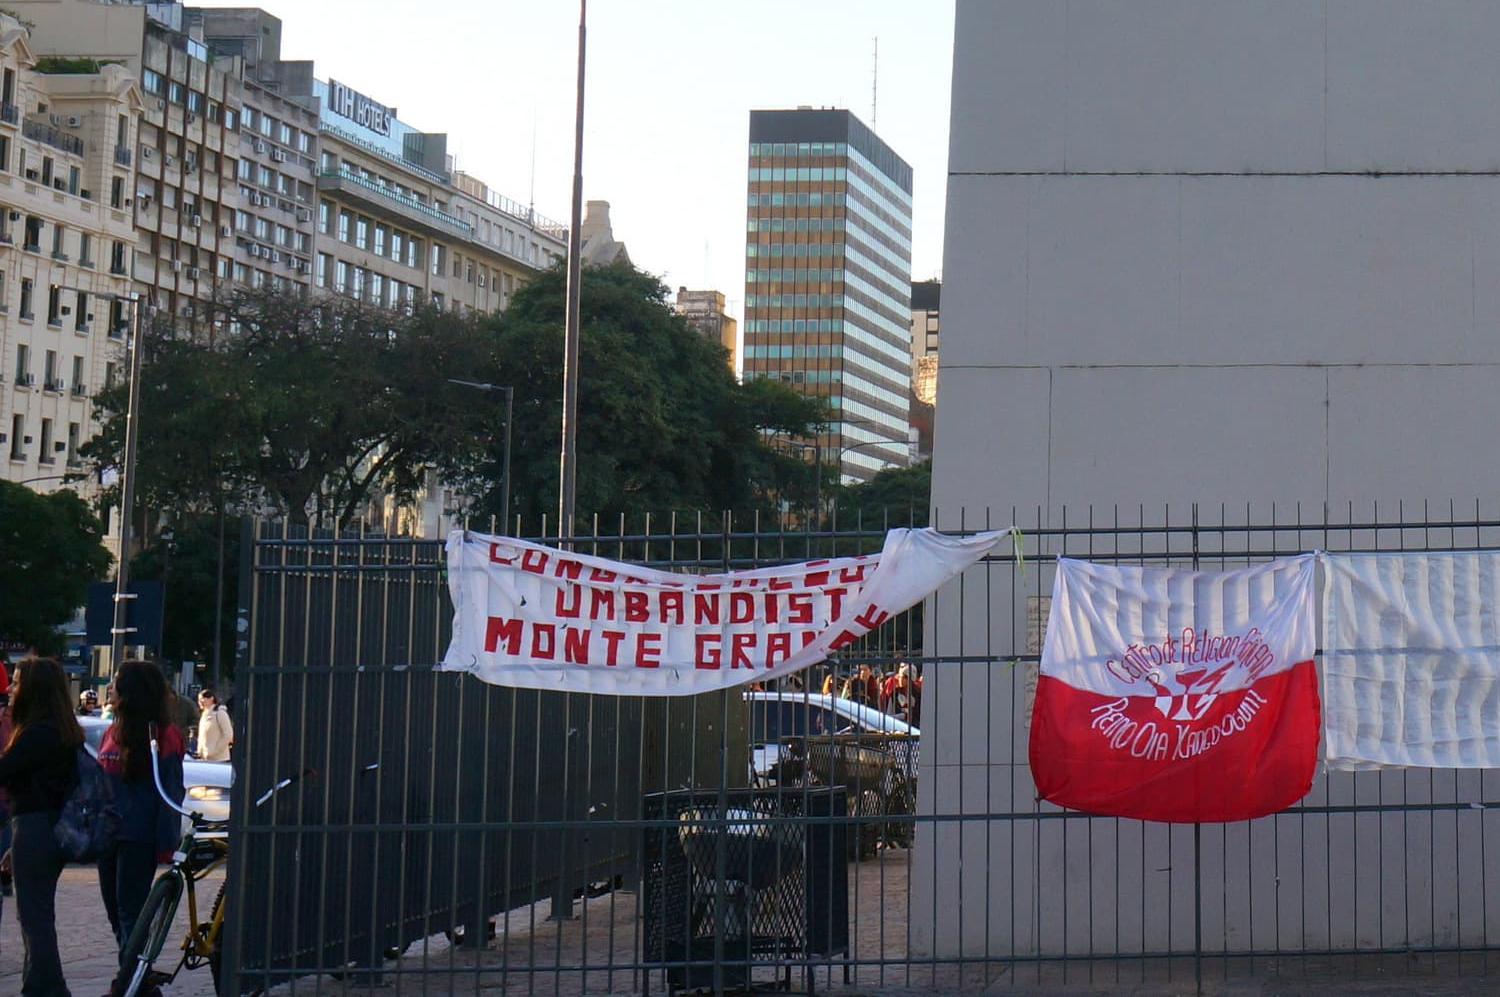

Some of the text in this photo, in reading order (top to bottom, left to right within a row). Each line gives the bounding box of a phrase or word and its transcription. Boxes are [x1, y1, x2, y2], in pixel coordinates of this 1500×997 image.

[358, 101, 391, 137] HOTELS
[555, 583, 865, 625] UMBANDIST
[484, 616, 662, 669] MONTE
